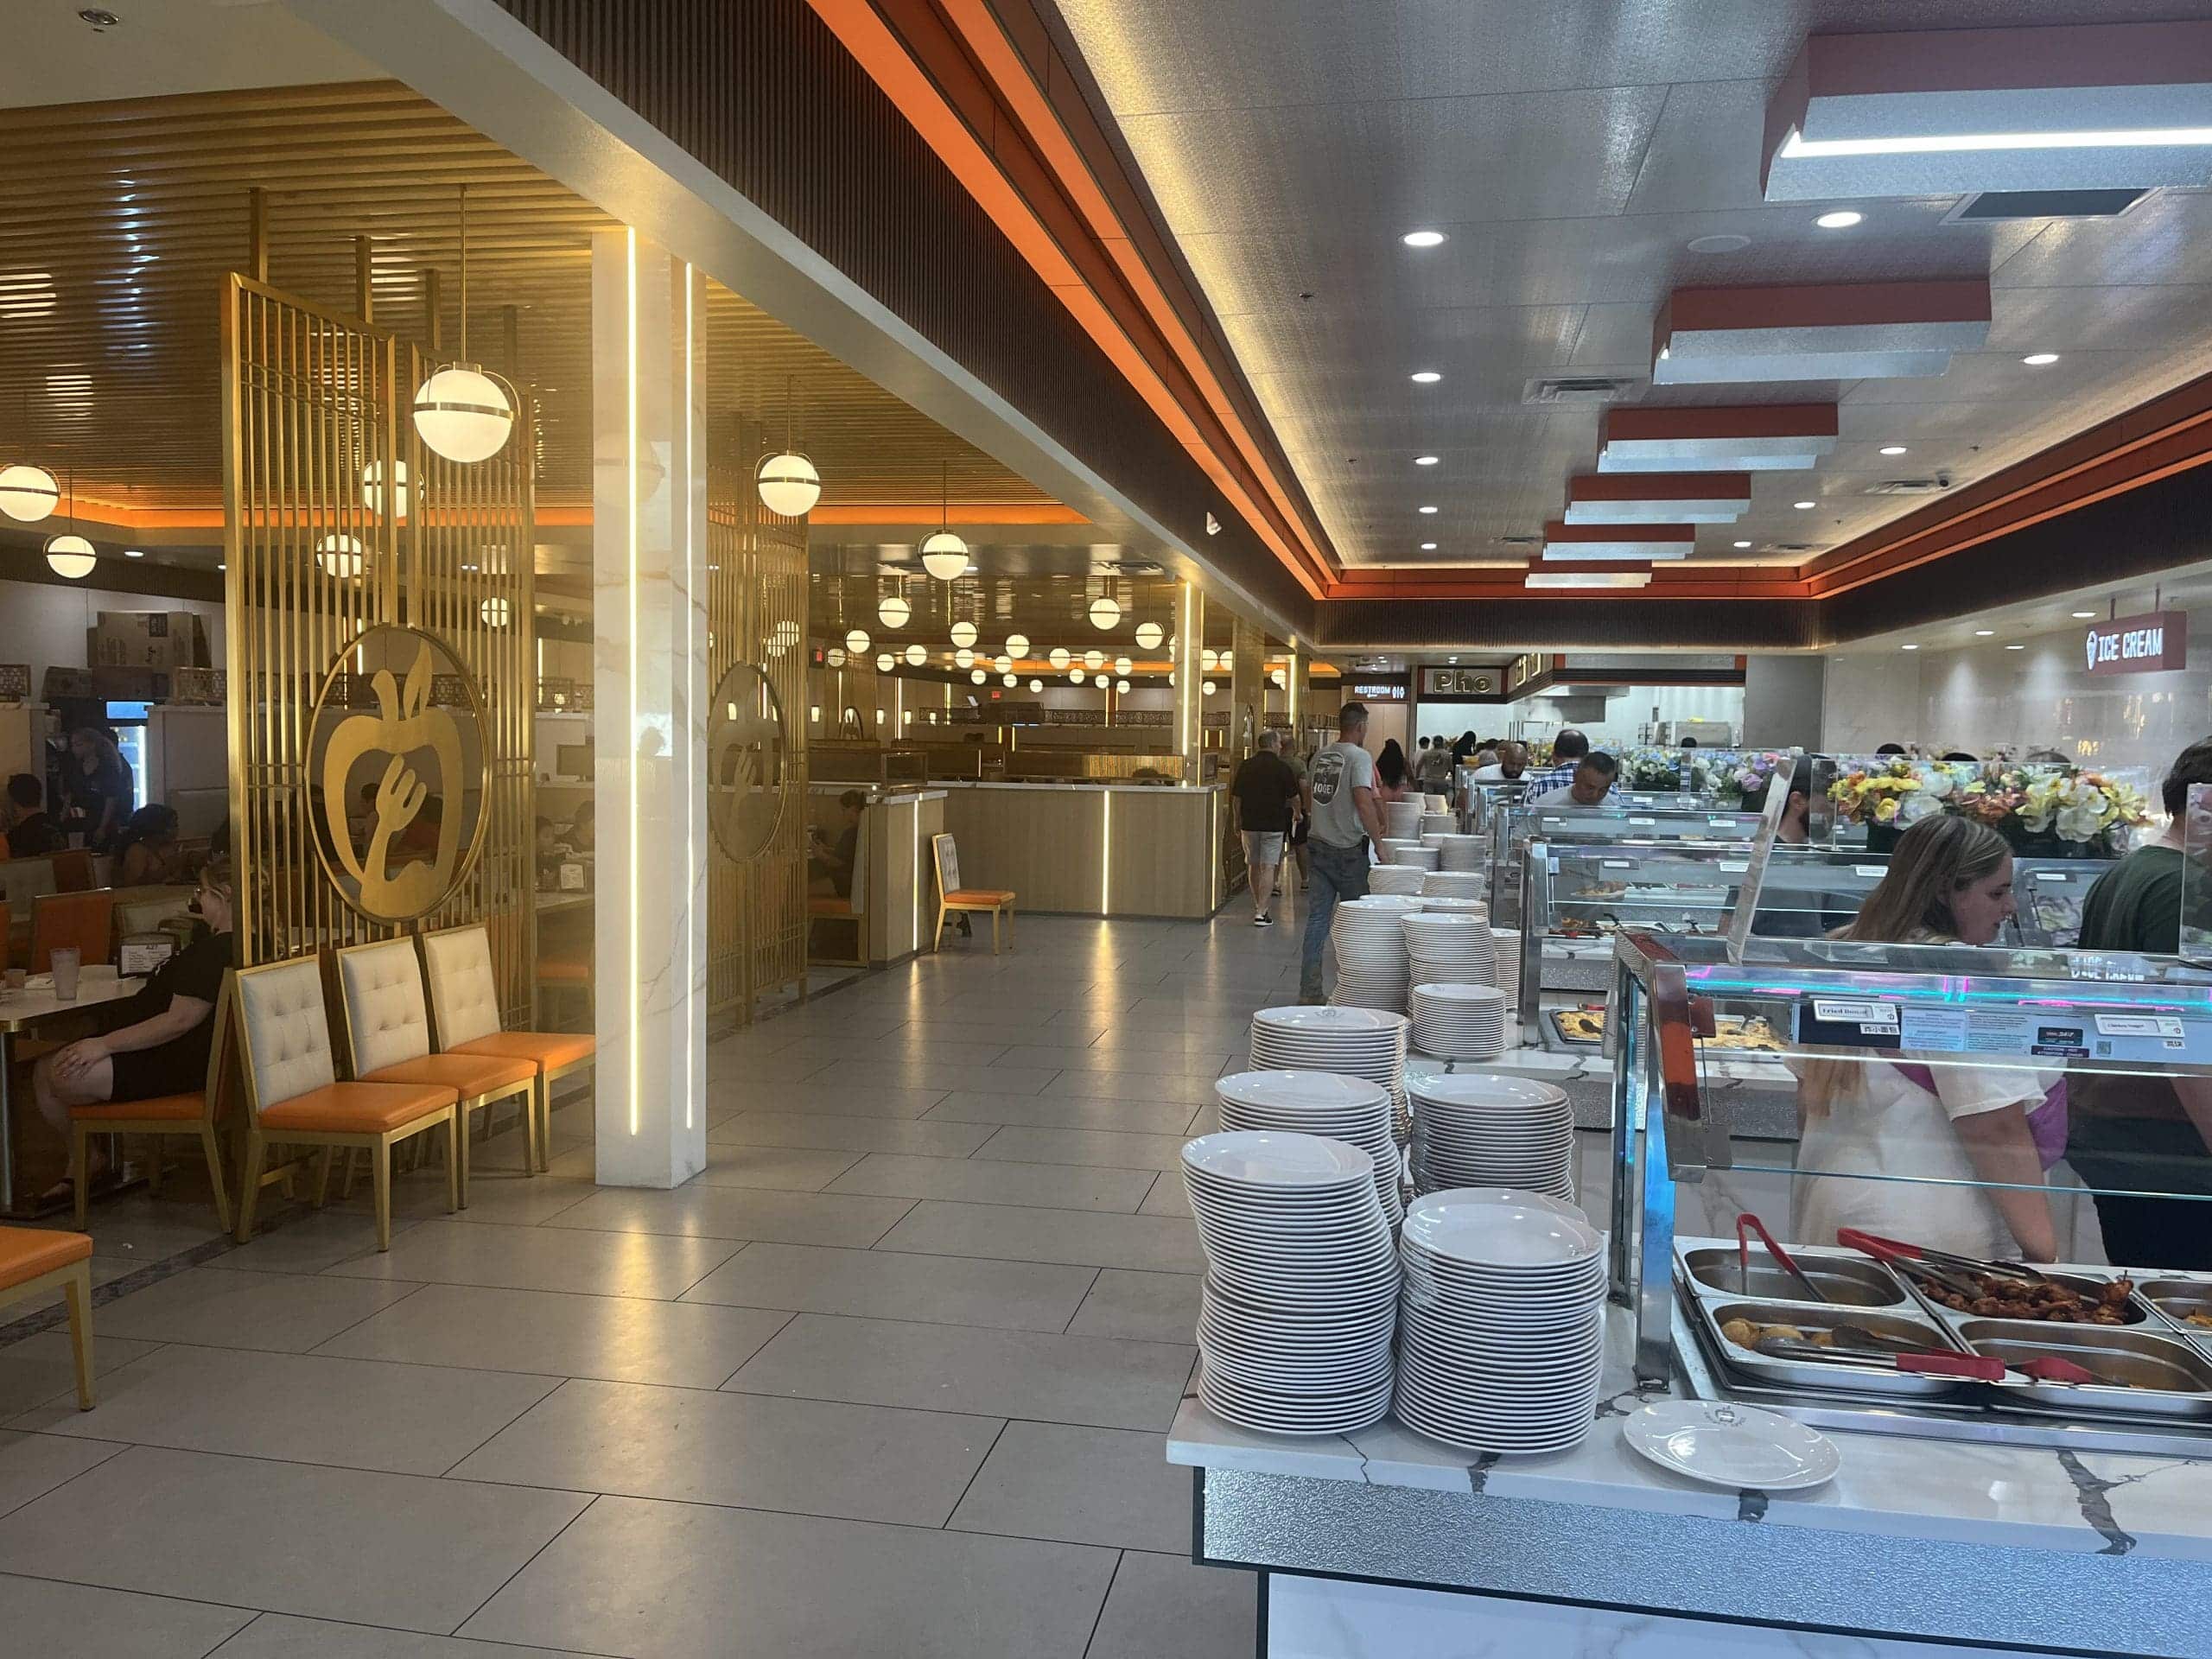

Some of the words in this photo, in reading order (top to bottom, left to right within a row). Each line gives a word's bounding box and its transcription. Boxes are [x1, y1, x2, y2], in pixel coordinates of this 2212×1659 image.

[2097, 633, 2120, 662] ICE
[2122, 627, 2164, 658] CREAM
[1354, 685, 1390, 694] RESTROOM
[1433, 670, 1493, 692] Pho
